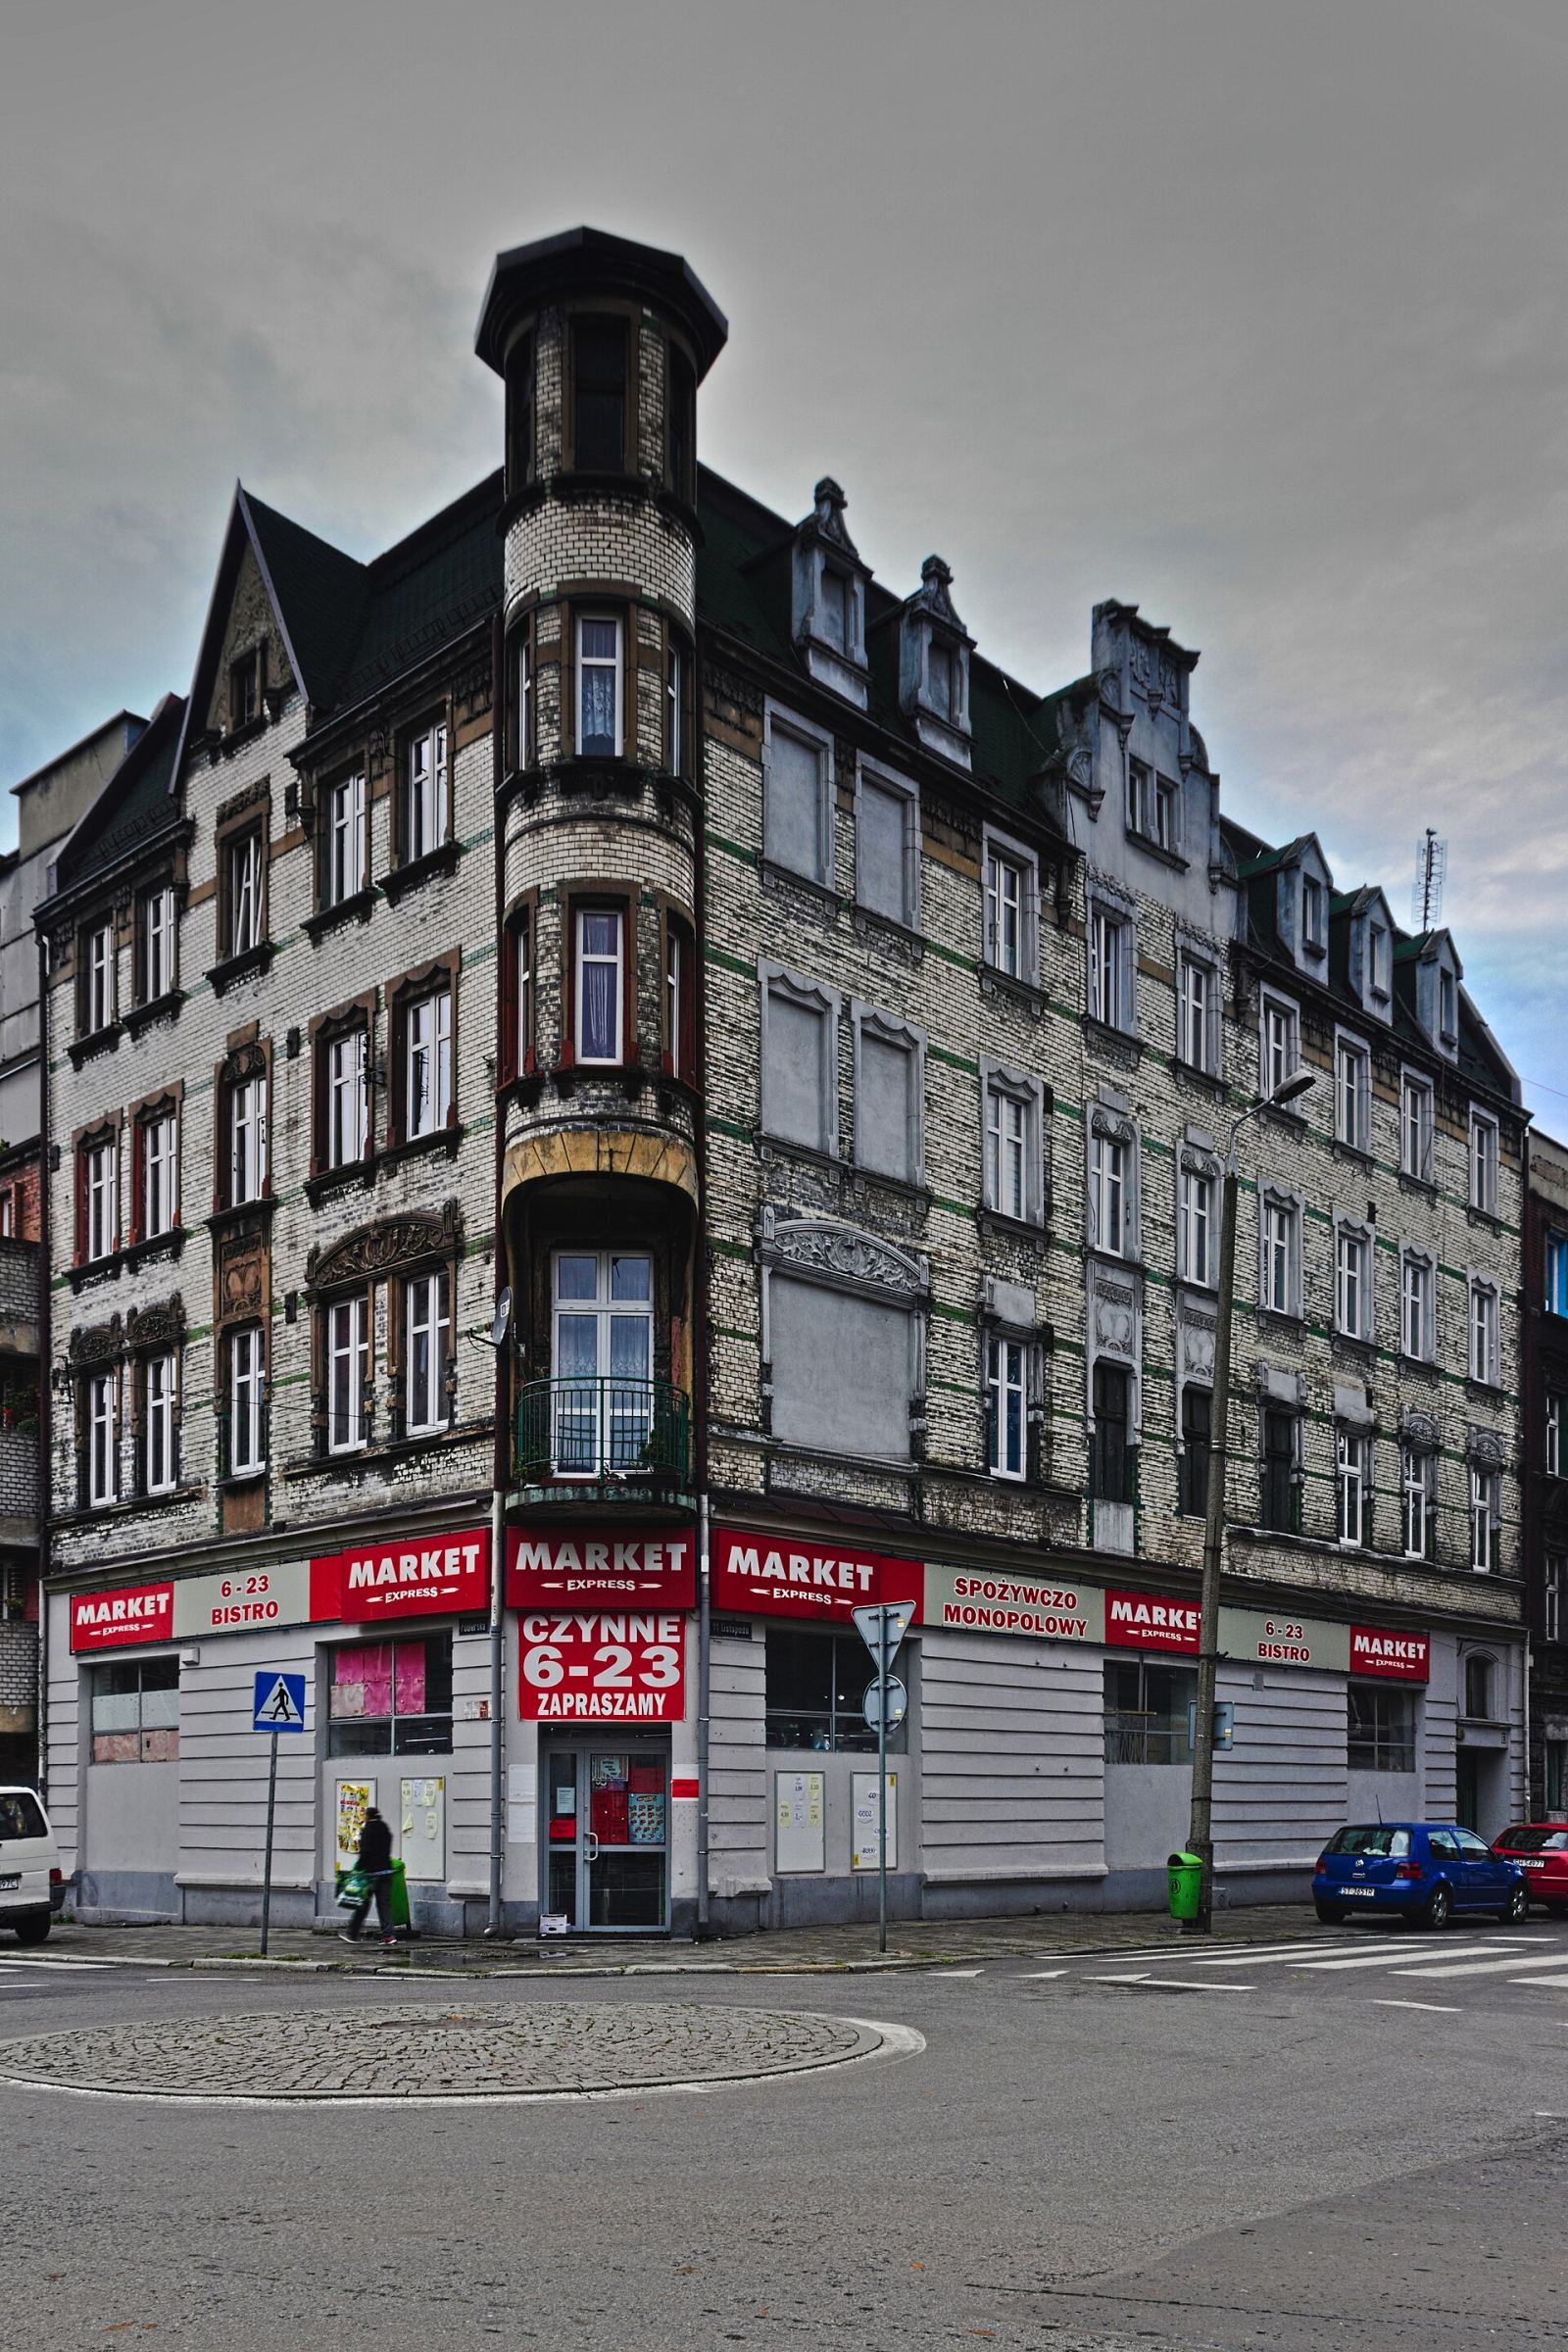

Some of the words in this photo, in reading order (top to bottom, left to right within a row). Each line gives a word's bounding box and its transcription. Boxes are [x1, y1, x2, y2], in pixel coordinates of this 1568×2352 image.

[348, 1544, 480, 1590] MARKET
[515, 1543, 687, 1571] MARKET
[727, 1544, 874, 1592] MARKET
[220, 1581, 232, 1597] 6
[246, 1574, 270, 1596] 23
[384, 1587, 438, 1603] EXPRESS
[566, 1579, 636, 1592] EXPRESS
[773, 1588, 832, 1605] EXPRESS
[954, 1576, 1077, 1611] SPOŻYWCZO
[75, 1592, 170, 1625] MARKET
[211, 1599, 279, 1626] BISTRO
[943, 1602, 1088, 1638] MONOPOLOWY
[1110, 1600, 1202, 1630] MARKE
[102, 1623, 140, 1637] EXPRESS
[522, 1614, 681, 1643] CZYNNE
[1142, 1628, 1182, 1642] EXPRESS
[1265, 1621, 1275, 1637] 6
[1285, 1623, 1303, 1640] 23
[1257, 1642, 1310, 1663] BISTRO
[1353, 1635, 1426, 1659] MARKET
[523, 1644, 681, 1688] 6-23
[1375, 1658, 1405, 1669] EXPRESS
[537, 1692, 666, 1716] ZAPRASZAMY
